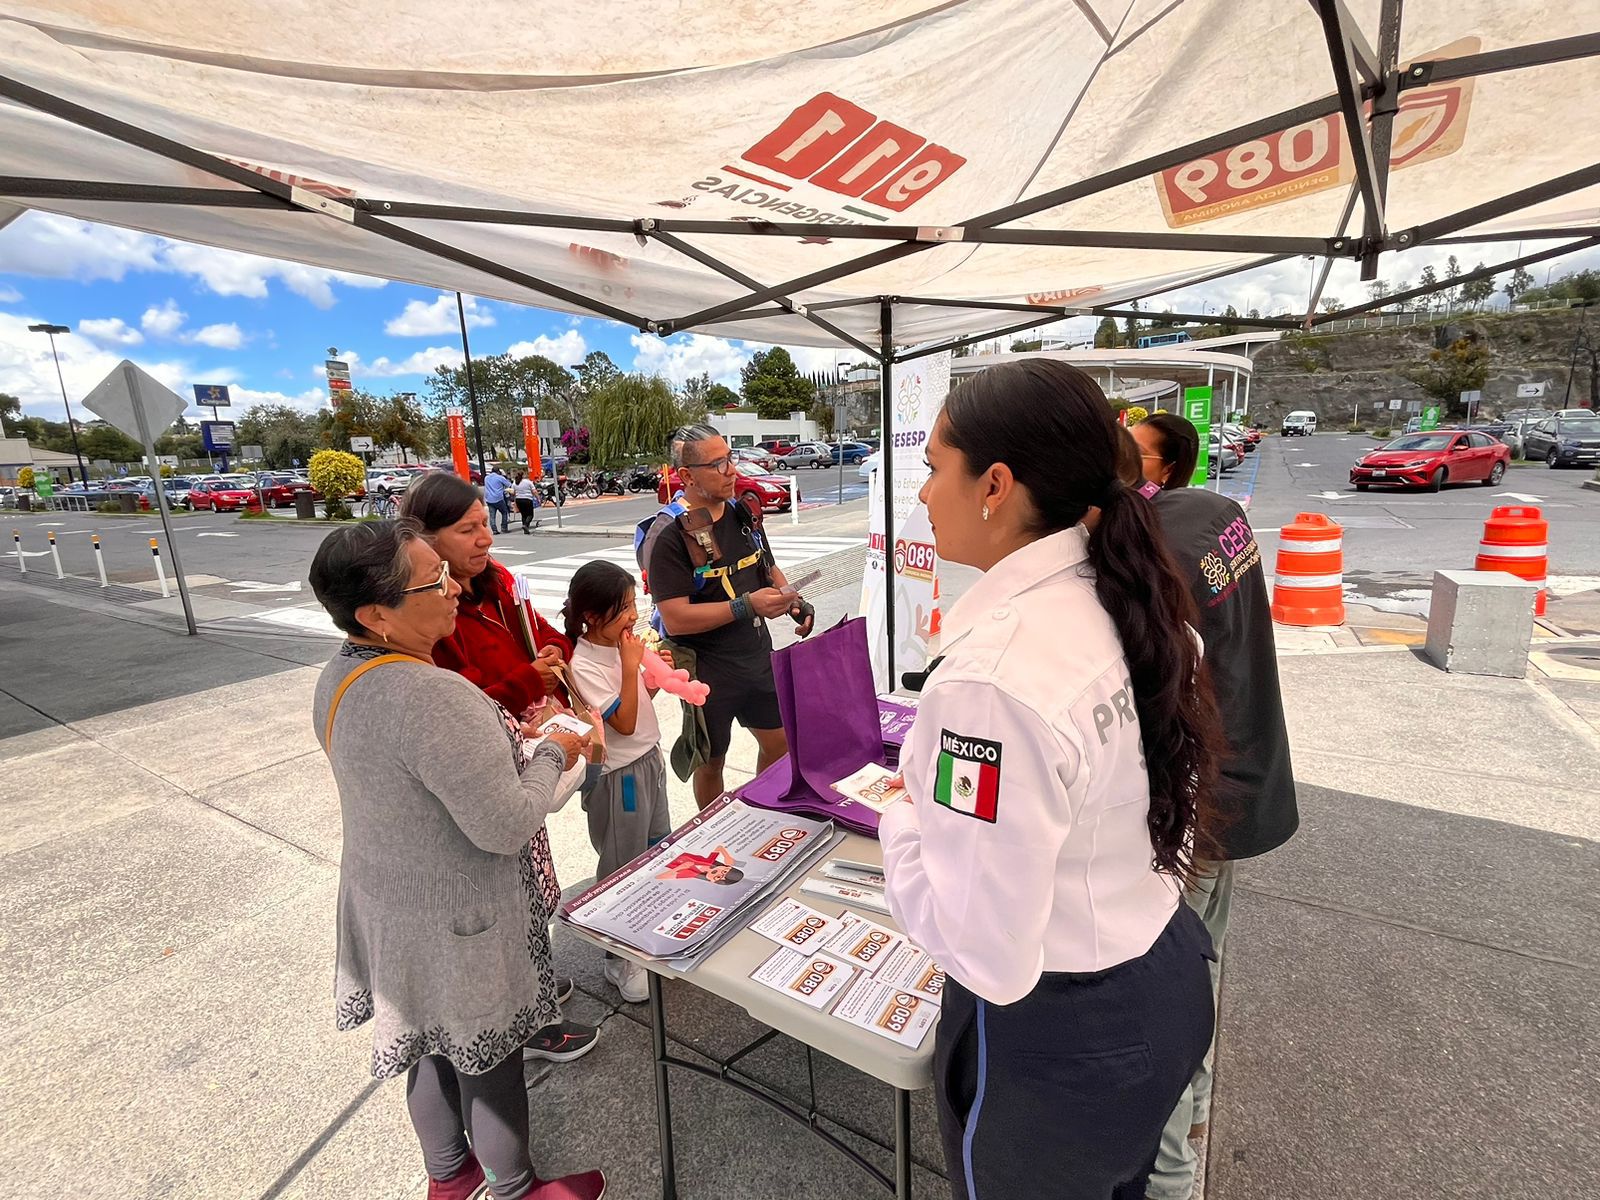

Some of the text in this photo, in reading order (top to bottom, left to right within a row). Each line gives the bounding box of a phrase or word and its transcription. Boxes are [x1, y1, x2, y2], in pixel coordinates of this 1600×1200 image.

[1190, 402, 1204, 419] E
[1218, 516, 1252, 558] CEPS
[907, 544, 933, 570] 089
[942, 735, 998, 762] MÉXICO
[763, 840, 795, 860] 089
[625, 896, 654, 916] seguridad
[662, 904, 705, 934] EMERGENCIAS
[677, 908, 717, 937] 911
[792, 927, 816, 945] 089
[858, 942, 882, 962] 089
[800, 974, 824, 995] 089
[925, 975, 946, 994] 089
[887, 1007, 911, 1032] 089
